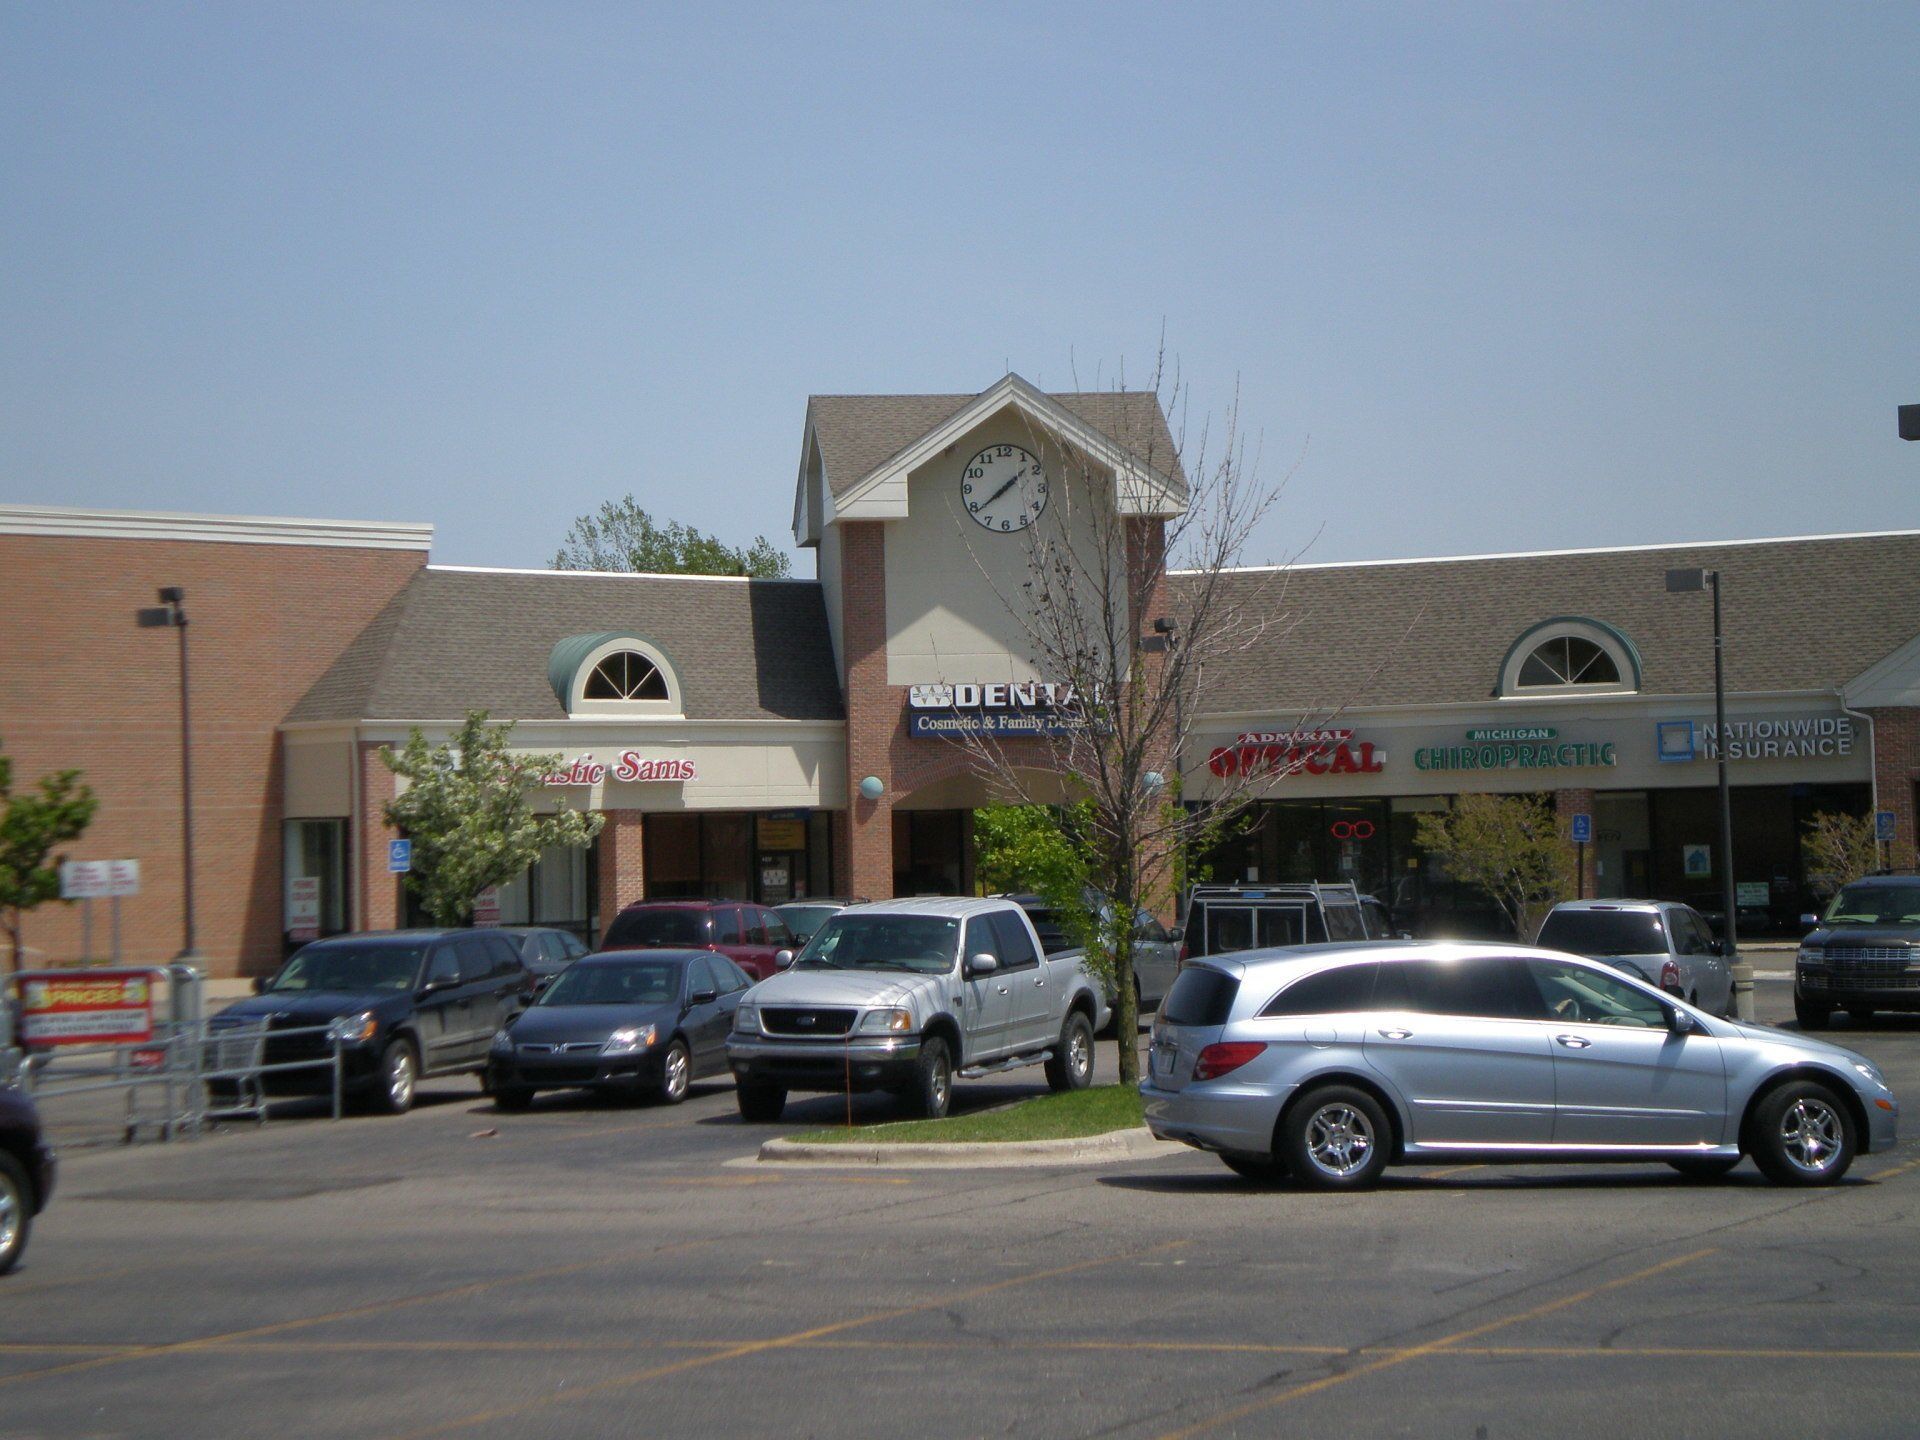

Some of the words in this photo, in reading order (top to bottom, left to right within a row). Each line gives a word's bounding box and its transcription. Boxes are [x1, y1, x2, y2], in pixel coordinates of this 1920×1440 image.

[996, 447, 1012, 457] 12
[1020, 452, 1027, 462] 1
[979, 454, 993, 464] 11
[968, 467, 983, 479] 10
[1032, 465, 1041, 475] 2
[963, 484, 972, 494] 9
[1037, 483, 1046, 493] 3
[969, 502, 978, 513] 8
[1031, 501, 1040, 511] 4
[984, 516, 993, 526] 7
[1001, 520, 1010, 530] 6
[1019, 515, 1028, 525] 5
[918, 716, 980, 731] Cosmetic
[982, 716, 996, 730] &
[999, 715, 1044, 733] Family
[1702, 717, 1852, 740] NATIONWIDE
[1244, 731, 1348, 744] ADMIRAL
[1473, 729, 1550, 740] MICHIGAN
[1209, 742, 1383, 778] OPTICAL
[1414, 742, 1615, 771] CHIROPRACTIC
[616, 750, 695, 781] Sams
